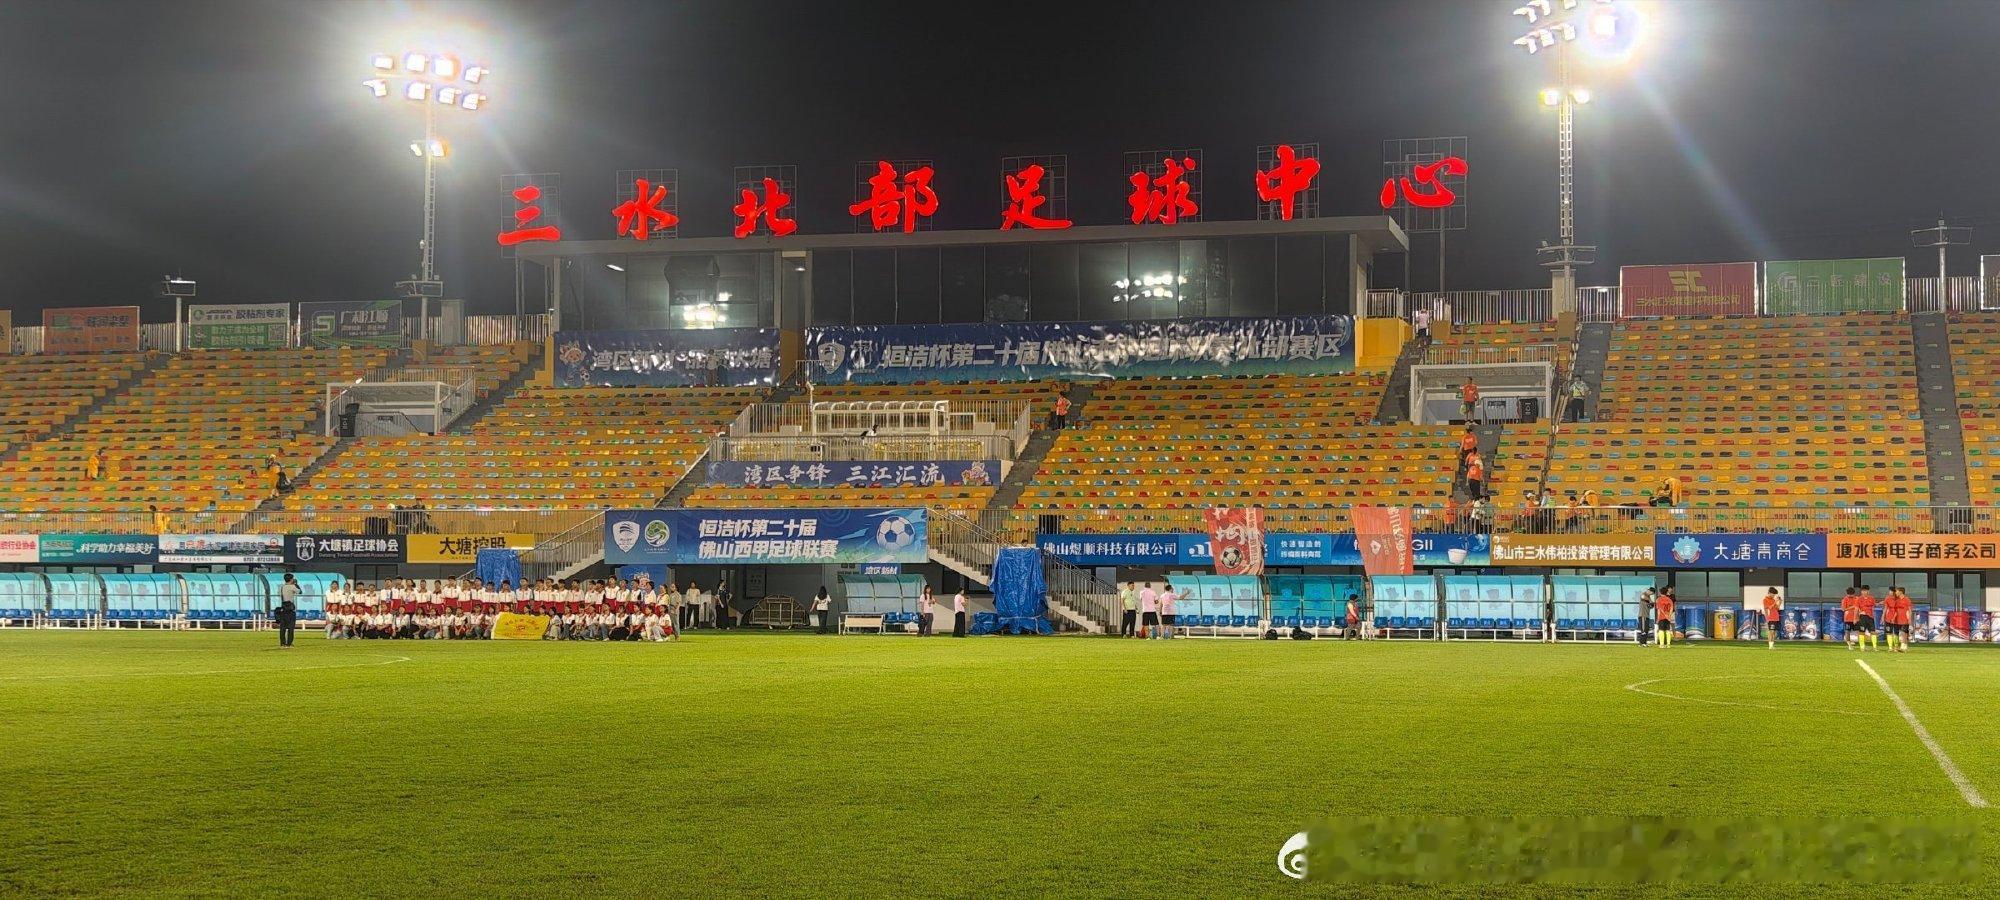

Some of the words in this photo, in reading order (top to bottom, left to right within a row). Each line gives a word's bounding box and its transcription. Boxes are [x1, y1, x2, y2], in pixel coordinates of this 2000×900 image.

[498, 145, 1468, 246] 三水北部足球中心
[744, 463, 831, 484] 湾区争锋
[846, 463, 945, 484] 三江汇流
[699, 519, 818, 539] 恒洁杯第二十届
[319, 539, 398, 551] 大塘镇足球协会
[699, 540, 839, 559] 佛山西甲足球联赛
[1493, 545, 1654, 560] 佛山市三水伟柏投资管理有限公司
[1714, 541, 1811, 560] 大塘青商会
[1836, 542, 1996, 559] 塘水铺电子商务公司
